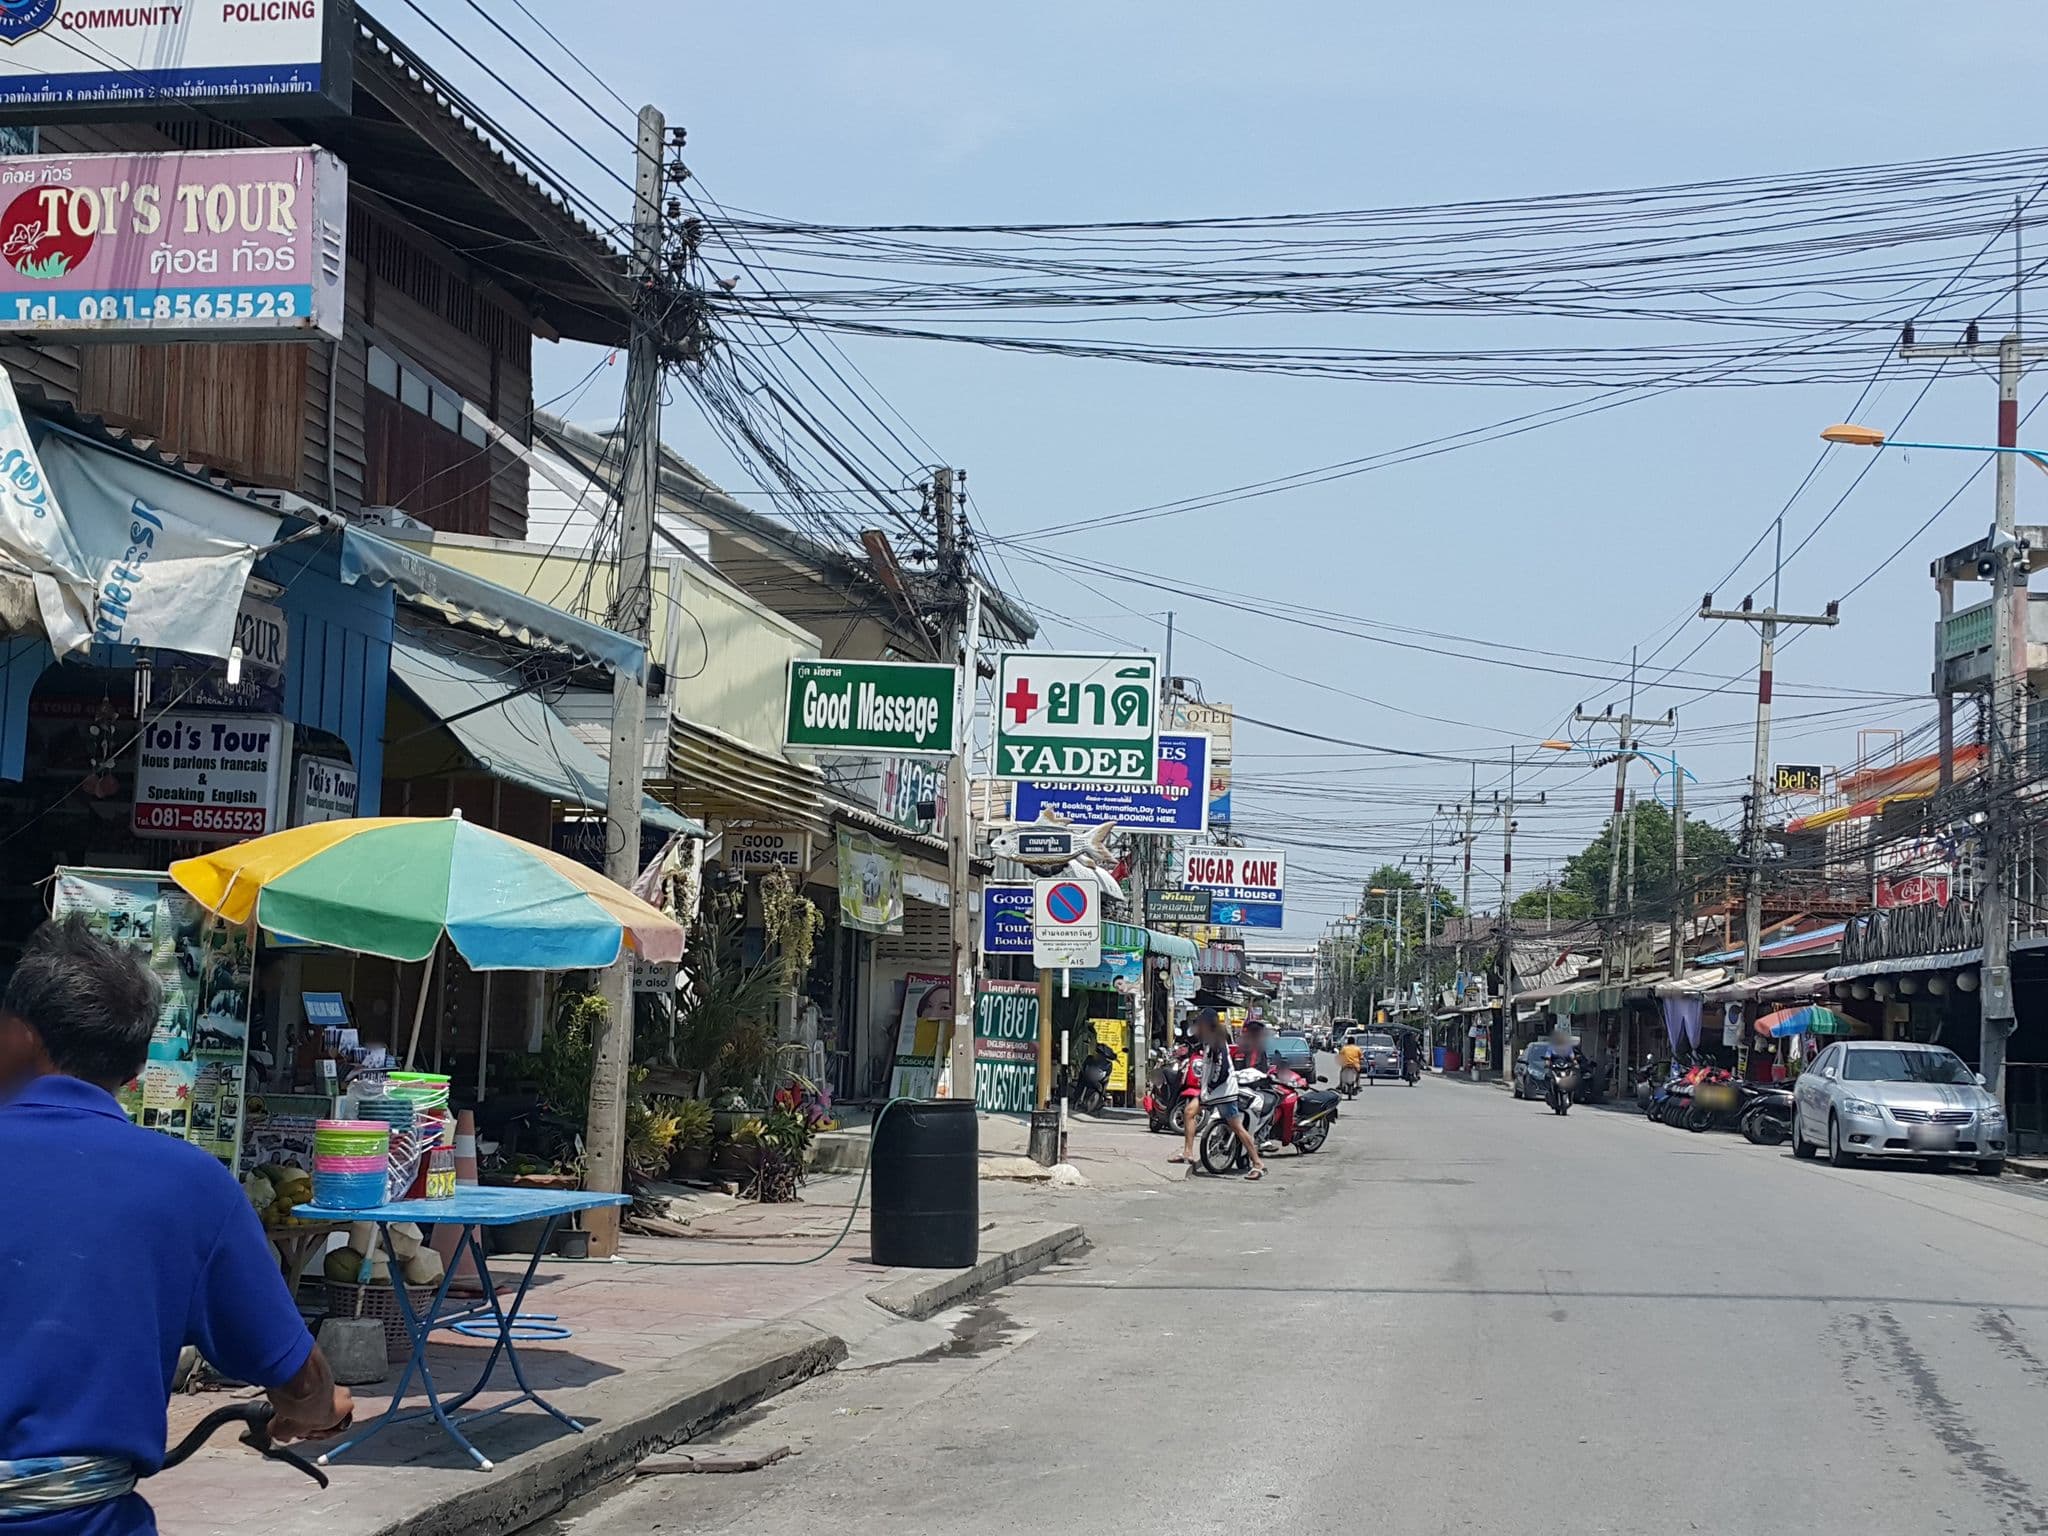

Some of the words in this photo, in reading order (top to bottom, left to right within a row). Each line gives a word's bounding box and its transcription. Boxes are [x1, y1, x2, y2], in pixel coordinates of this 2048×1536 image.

[61, 6, 183, 30] COMMUNITY
[222, 1, 315, 23] POLICING
[66, 91, 73, 101] 8
[2, 167, 35, 185] ต้อย
[40, 162, 73, 182] ทัวร์
[38, 181, 161, 237] TOI'S
[177, 181, 298, 235] TOUR
[150, 242, 218, 275] ต้อย
[232, 237, 296, 273] ทัวร์
[16, 296, 66, 320] Tel.
[78, 291, 296, 320] 081-8565523
[1047, 666, 1151, 727] ยาดี
[803, 680, 852, 729] Good
[857, 682, 939, 743] Massage
[143, 719, 201, 751] Toi's
[211, 723, 270, 753] Tour
[141, 754, 170, 769] Nous
[173, 755, 217, 772] parlons
[220, 758, 267, 773] francais
[1005, 745, 1146, 778] YADEE
[197, 773, 207, 785] &
[334, 773, 356, 799] Tour
[1778, 769, 1819, 789] Bell's
[148, 785, 205, 803] Speaking
[211, 788, 257, 804] English
[151, 807, 263, 832] 081-8565523
[742, 835, 784, 848] GOOD
[731, 850, 799, 864] MASSAGE
[1188, 857, 1234, 884] SUGAR
[1242, 860, 1278, 887] CANE
[993, 894, 1033, 904] GOOD
[1234, 887, 1277, 900] House
[980, 993, 1039, 1040] ขายยา
[975, 1062, 1036, 1112] DRUGSTORE
